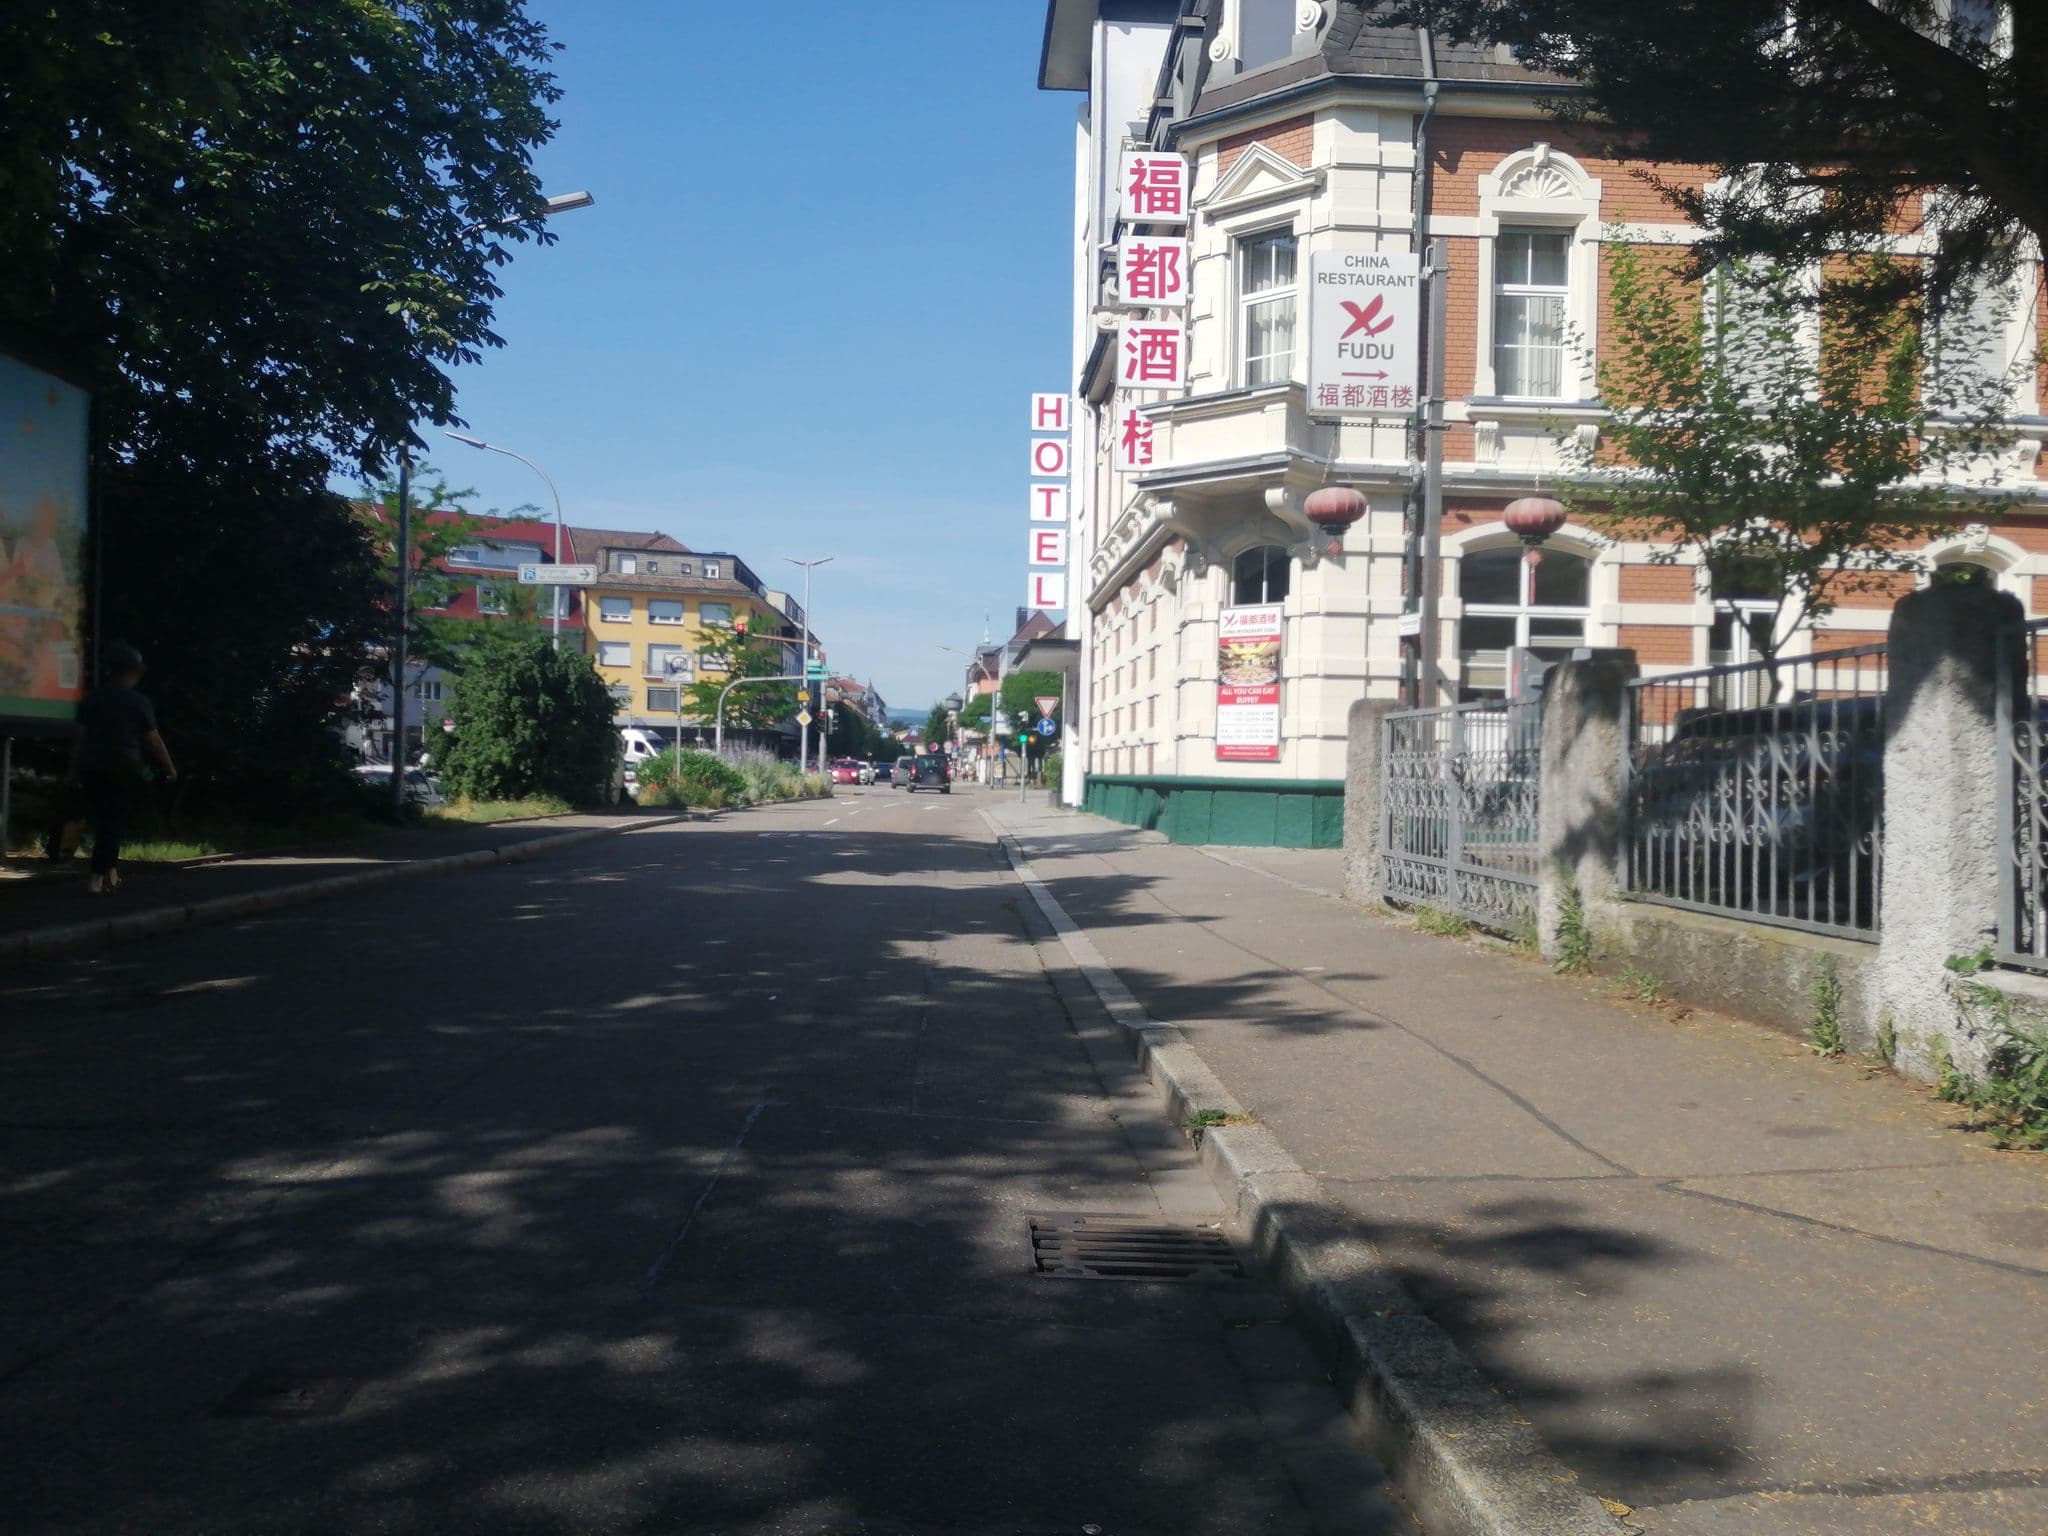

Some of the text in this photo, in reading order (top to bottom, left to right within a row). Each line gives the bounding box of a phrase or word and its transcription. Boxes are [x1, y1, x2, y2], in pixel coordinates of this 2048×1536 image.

[1344, 255, 1390, 269] CHINA
[1318, 272, 1416, 287] RESTAURANT
[1337, 342, 1394, 360] FUDU
[1317, 383, 1413, 409] 福都酒楼
[1035, 397, 1063, 606] HOTEL
[1221, 687, 1233, 695] ALL
[1233, 687, 1247, 695] YOU
